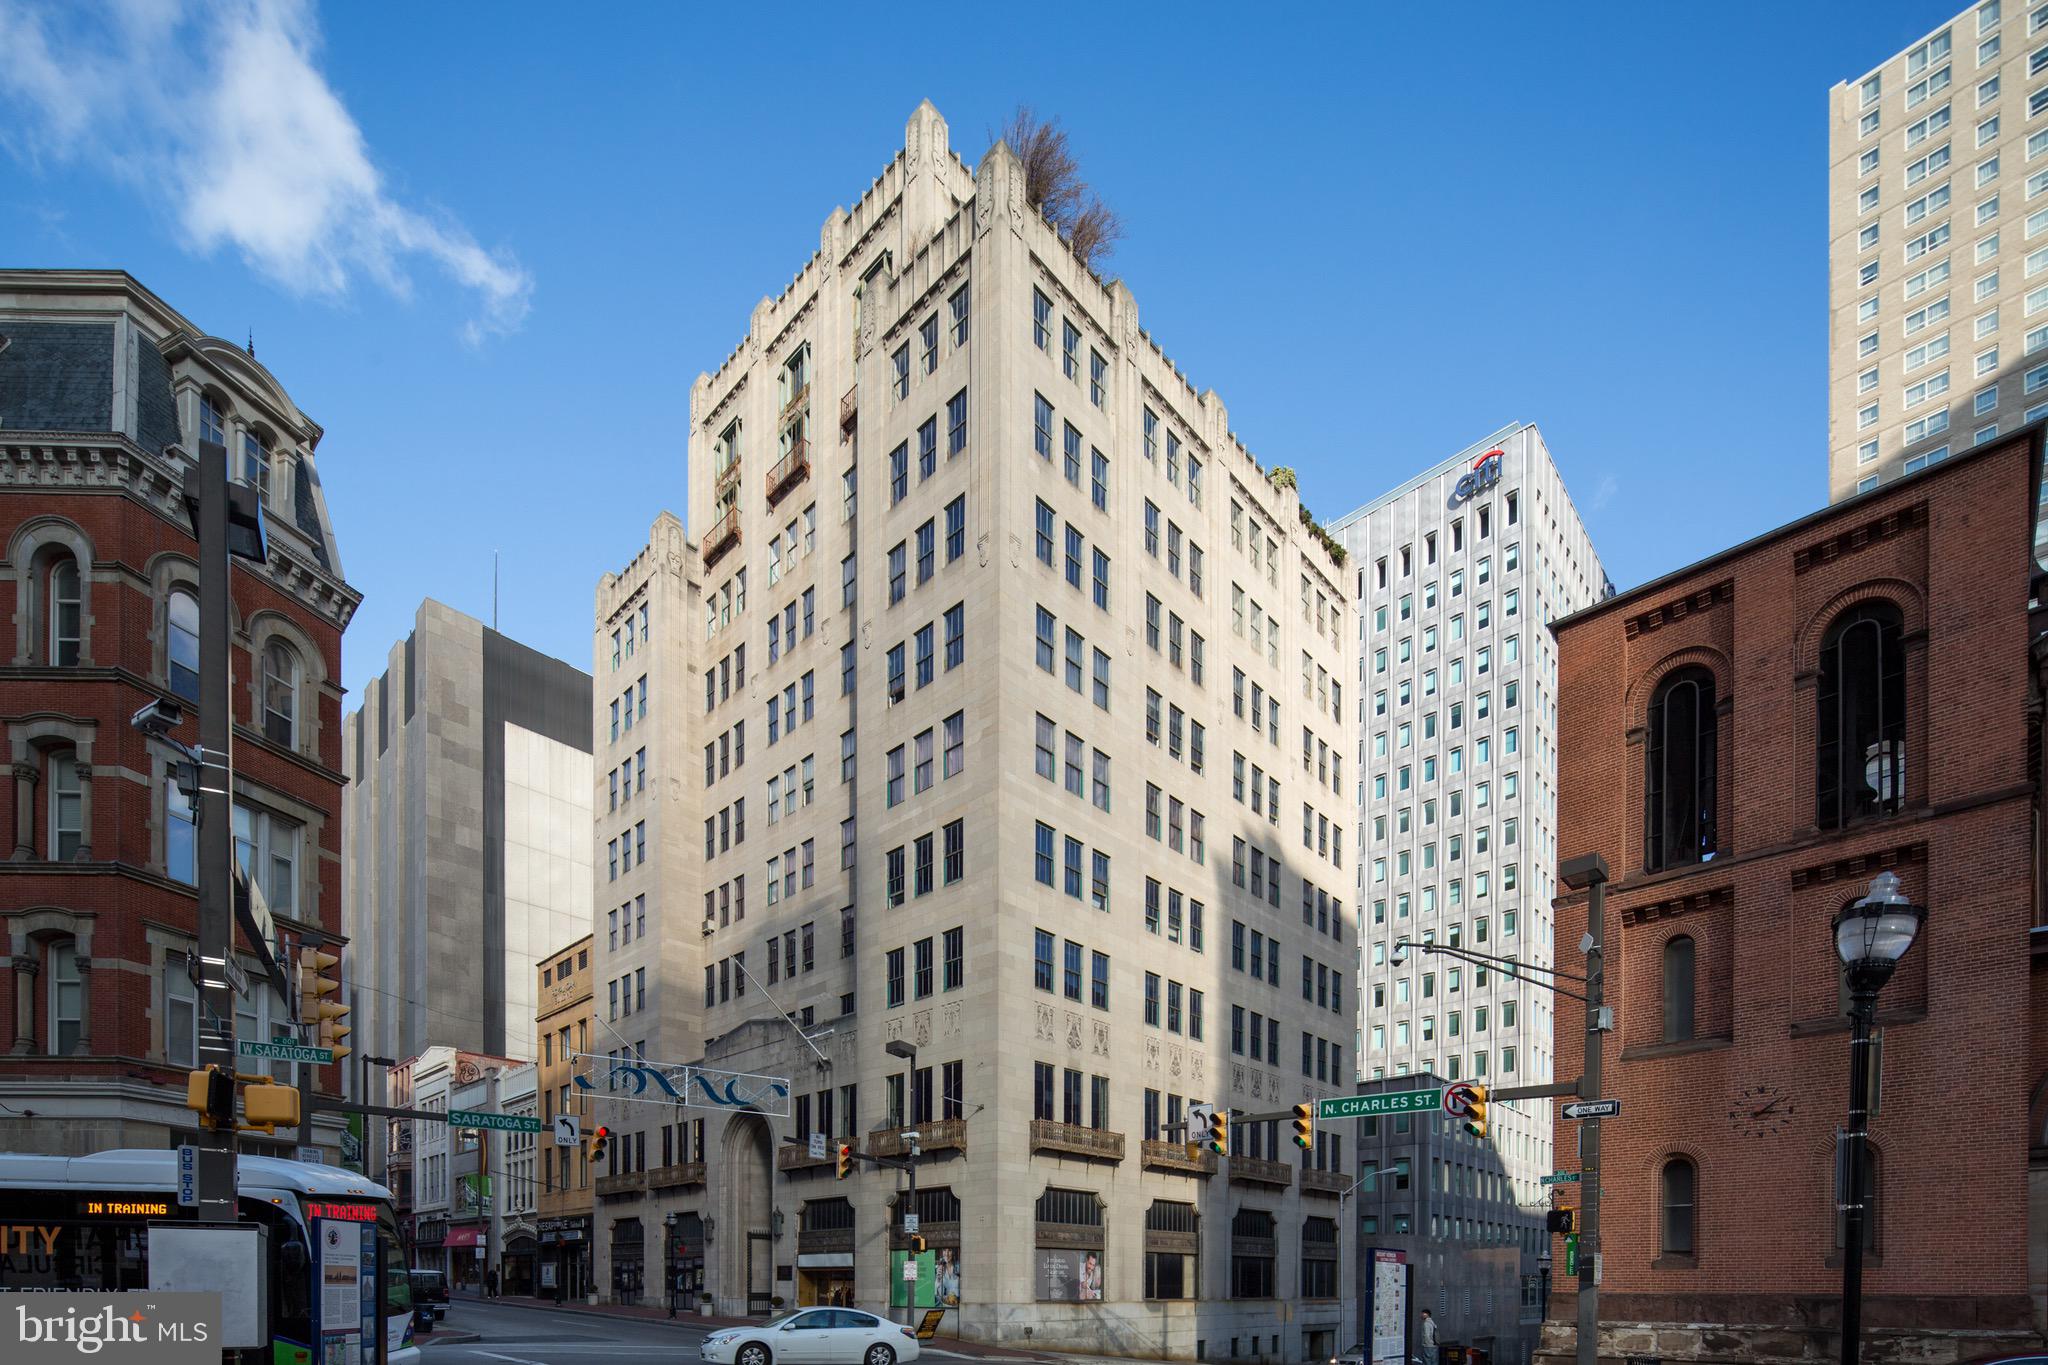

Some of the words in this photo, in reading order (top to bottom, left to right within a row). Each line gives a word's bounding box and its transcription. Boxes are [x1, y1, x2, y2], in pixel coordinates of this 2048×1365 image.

[242, 1043, 253, 1055] W
[255, 1044, 318, 1061] SARATOGA
[319, 1052, 328, 1060] ST
[1325, 1104, 1337, 1114] N.
[1341, 1096, 1408, 1113] CHARLES
[1414, 1094, 1435, 1107] ST.
[1577, 1106, 1592, 1114] ONE
[1594, 1104, 1610, 1112] WAY
[452, 1112, 521, 1129] SARATOGA
[524, 1120, 539, 1130] ST.
[558, 1136, 577, 1144] ONLY
[1191, 1130, 1210, 1139] ONLY
[183, 1148, 193, 1171] BUS
[183, 1174, 193, 1203] STOP
[88, 1203, 103, 1214] IN
[107, 1203, 167, 1215] TRAINING
[308, 1204, 321, 1219] IN
[325, 1204, 377, 1220] TRAINING
